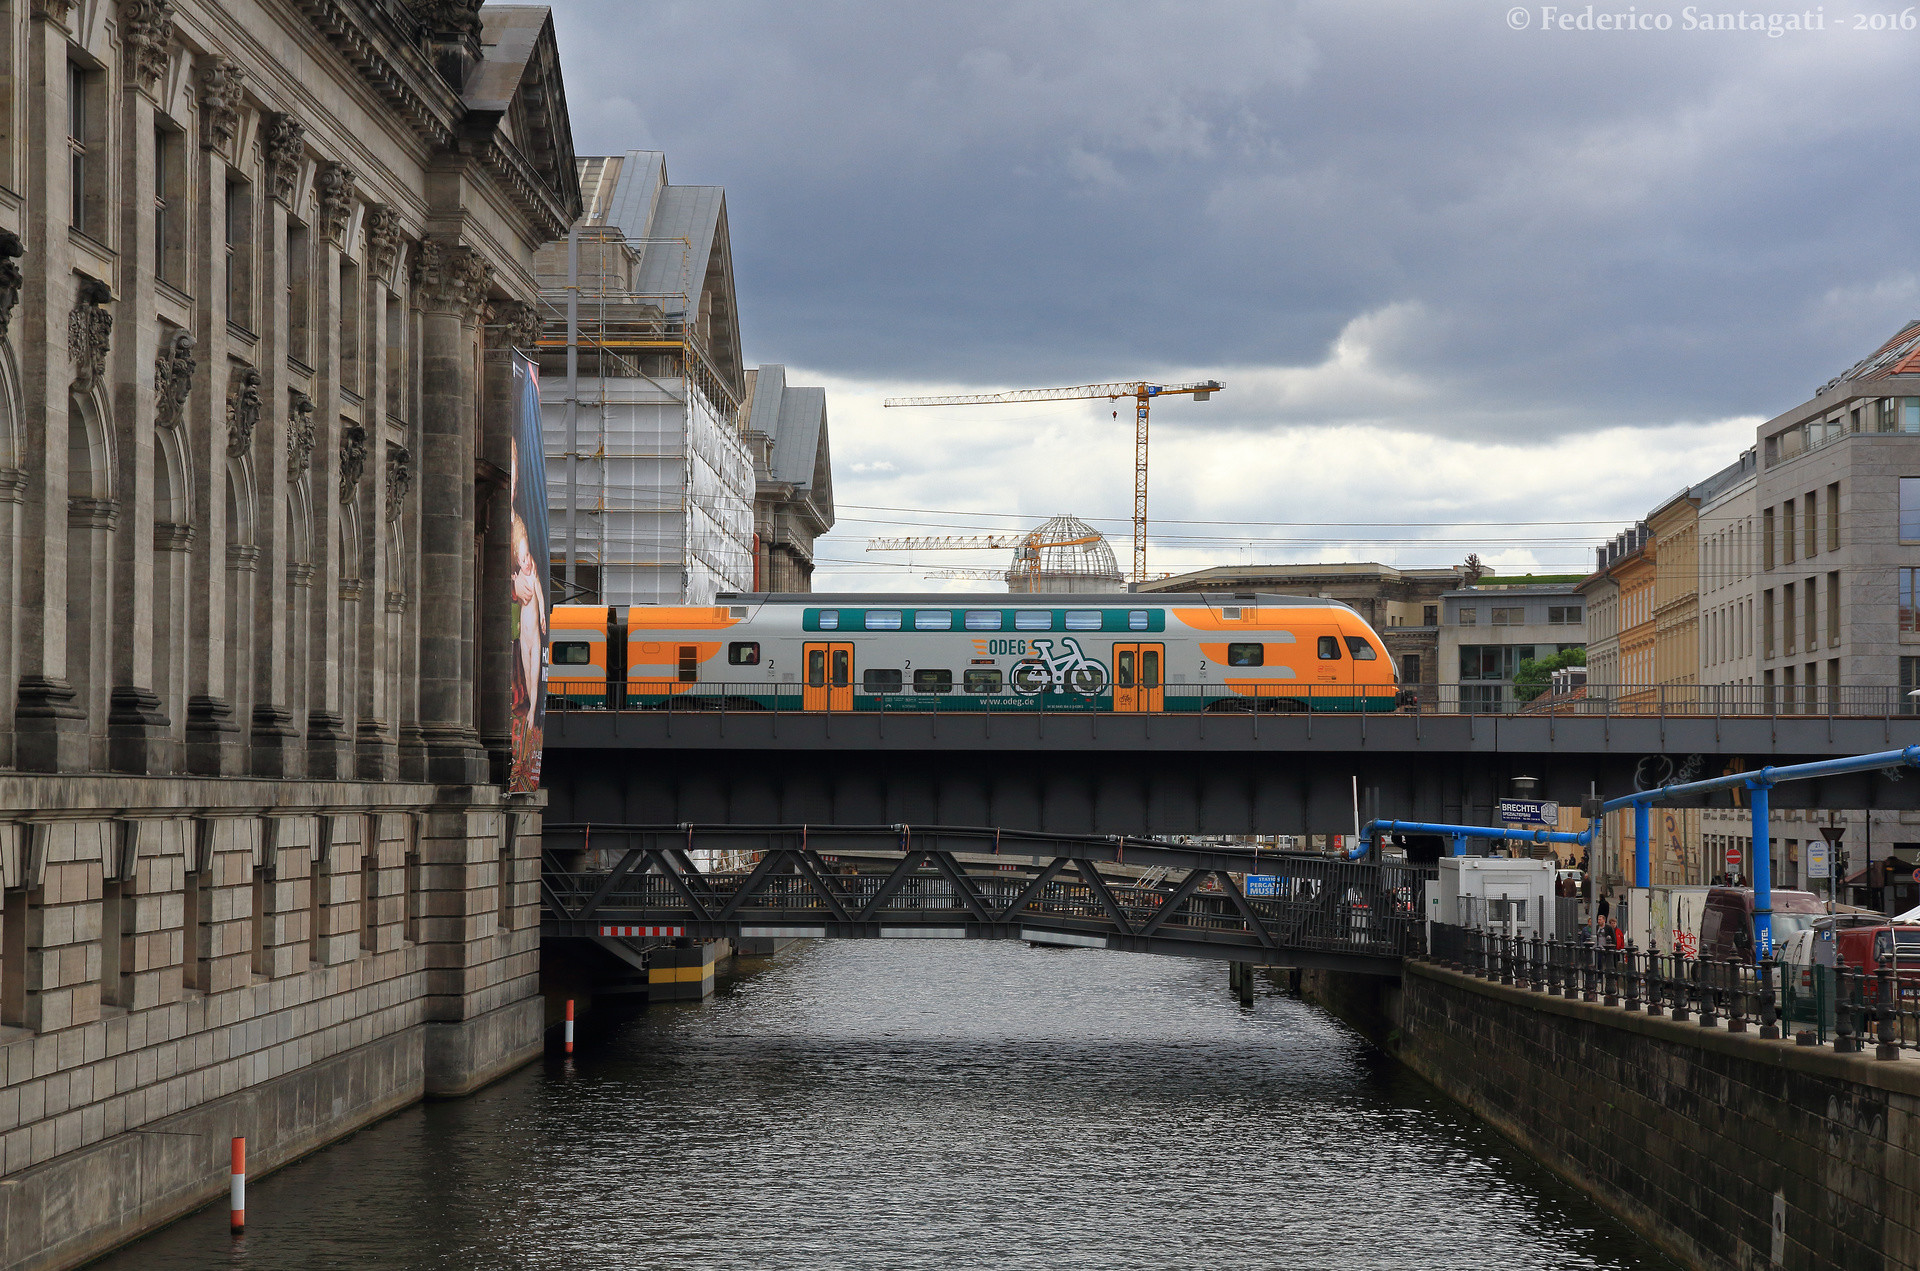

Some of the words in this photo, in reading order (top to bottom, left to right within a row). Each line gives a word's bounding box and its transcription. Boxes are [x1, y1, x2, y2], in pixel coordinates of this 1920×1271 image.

[989, 639, 1026, 655] ODEG
[768, 660, 775, 669] 2
[905, 660, 911, 669] 2
[1200, 660, 1206, 670] 2
[980, 698, 1034, 706] www.odeg.de
[1502, 803, 1540, 813] BRECHTEL
[1824, 931, 1831, 940] P
